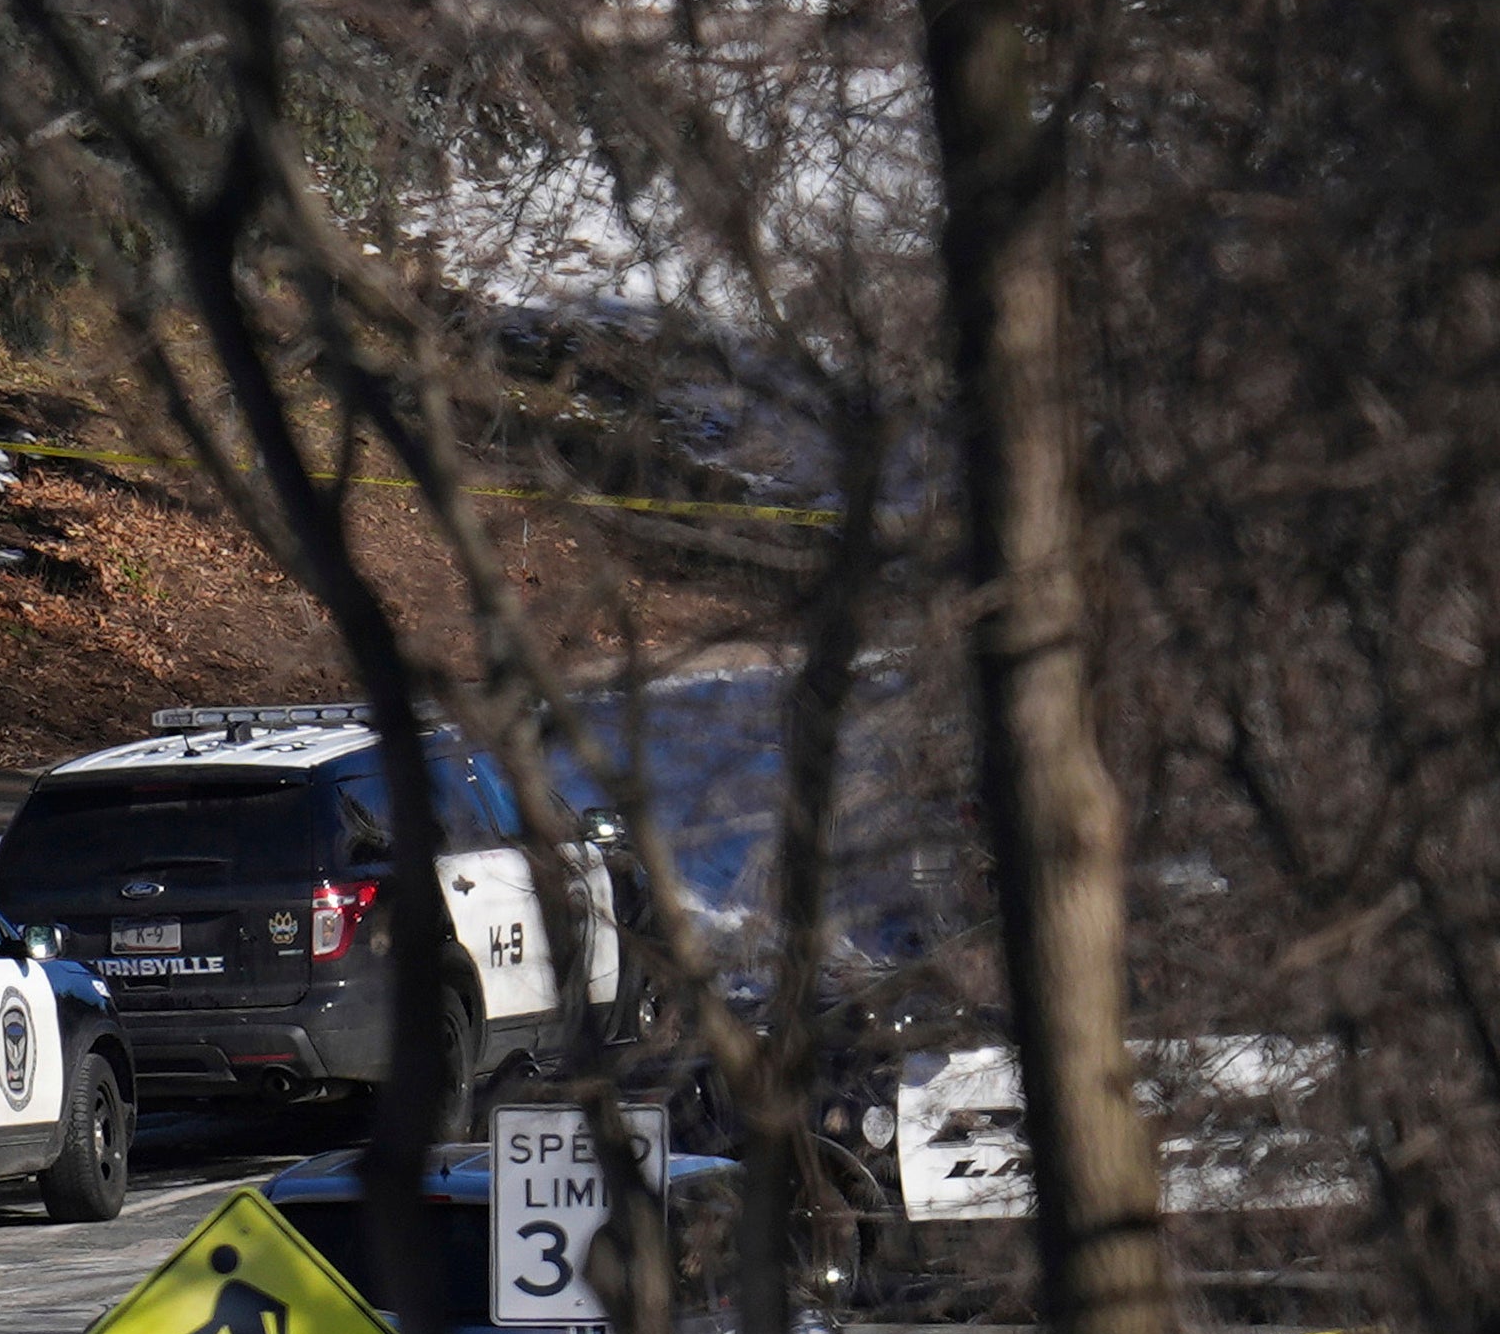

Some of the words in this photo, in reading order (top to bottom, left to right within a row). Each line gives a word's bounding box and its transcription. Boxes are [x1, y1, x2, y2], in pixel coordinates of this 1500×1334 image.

[136, 926, 163, 944] K-9
[489, 922, 523, 968] K-9
[509, 1133, 652, 1165] SPED
